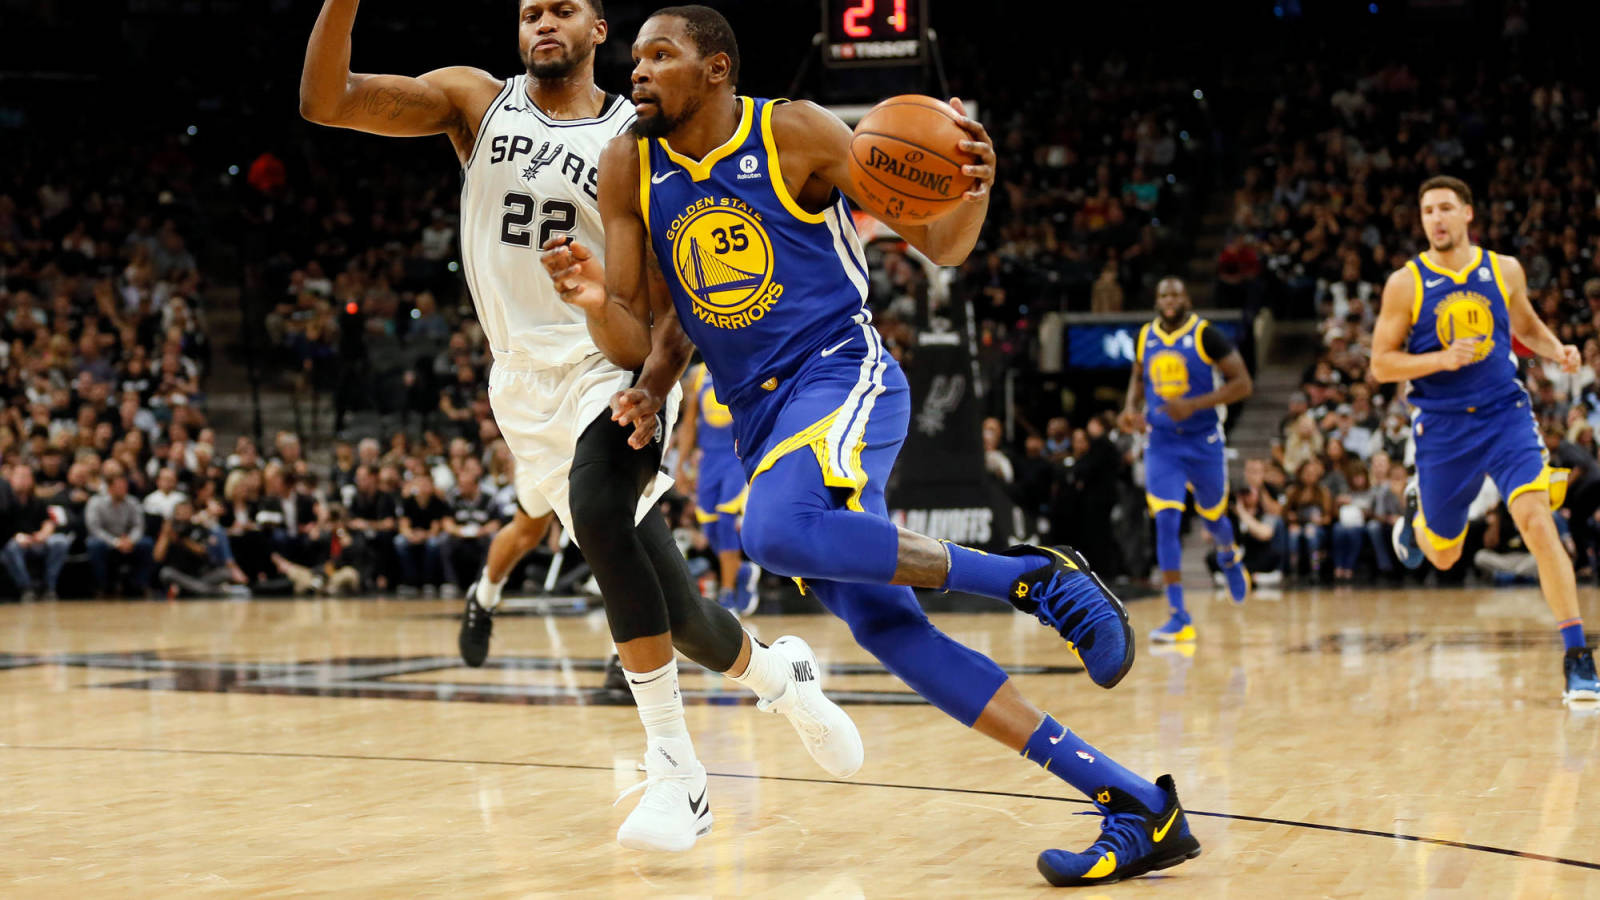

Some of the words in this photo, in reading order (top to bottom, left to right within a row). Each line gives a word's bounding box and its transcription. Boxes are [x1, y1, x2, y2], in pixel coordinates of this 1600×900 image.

[865, 146, 953, 197] SPALDING
[500, 190, 578, 251] 22
[666, 196, 716, 241] GOLDEN
[720, 197, 764, 222] STATE
[711, 222, 750, 255] 35
[691, 281, 784, 330] WARRIORS
[1467, 309, 1479, 325] 11
[791, 660, 815, 682] NIKE
